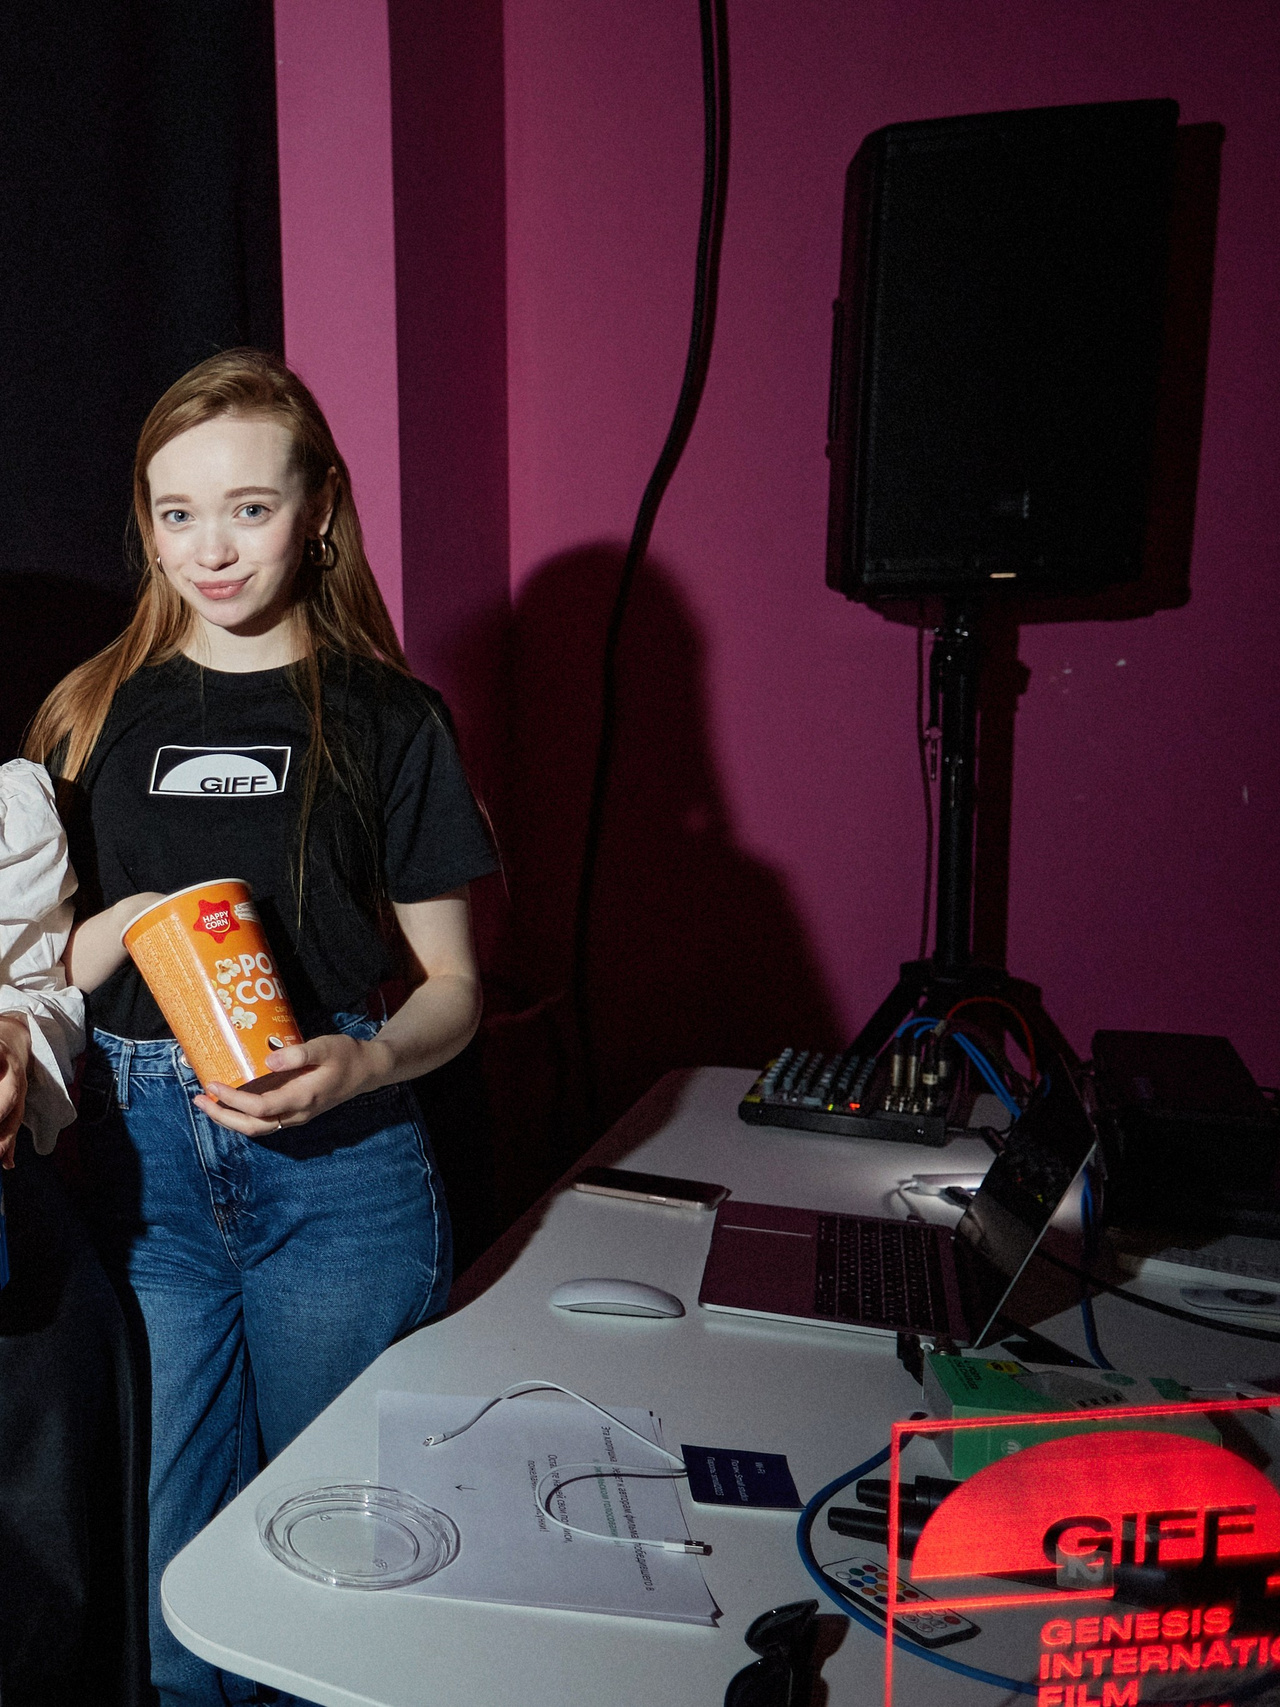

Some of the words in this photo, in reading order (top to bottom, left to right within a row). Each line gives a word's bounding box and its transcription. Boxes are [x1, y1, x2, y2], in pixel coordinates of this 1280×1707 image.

[200, 775, 269, 793] GIFF
[202, 910, 229, 923] HAPPY
[205, 918, 229, 930] CORN
[1041, 1504, 1257, 1569] GIFF
[1039, 1606, 1232, 1647] GENESIS
[1036, 1679, 1139, 1707] FILM
